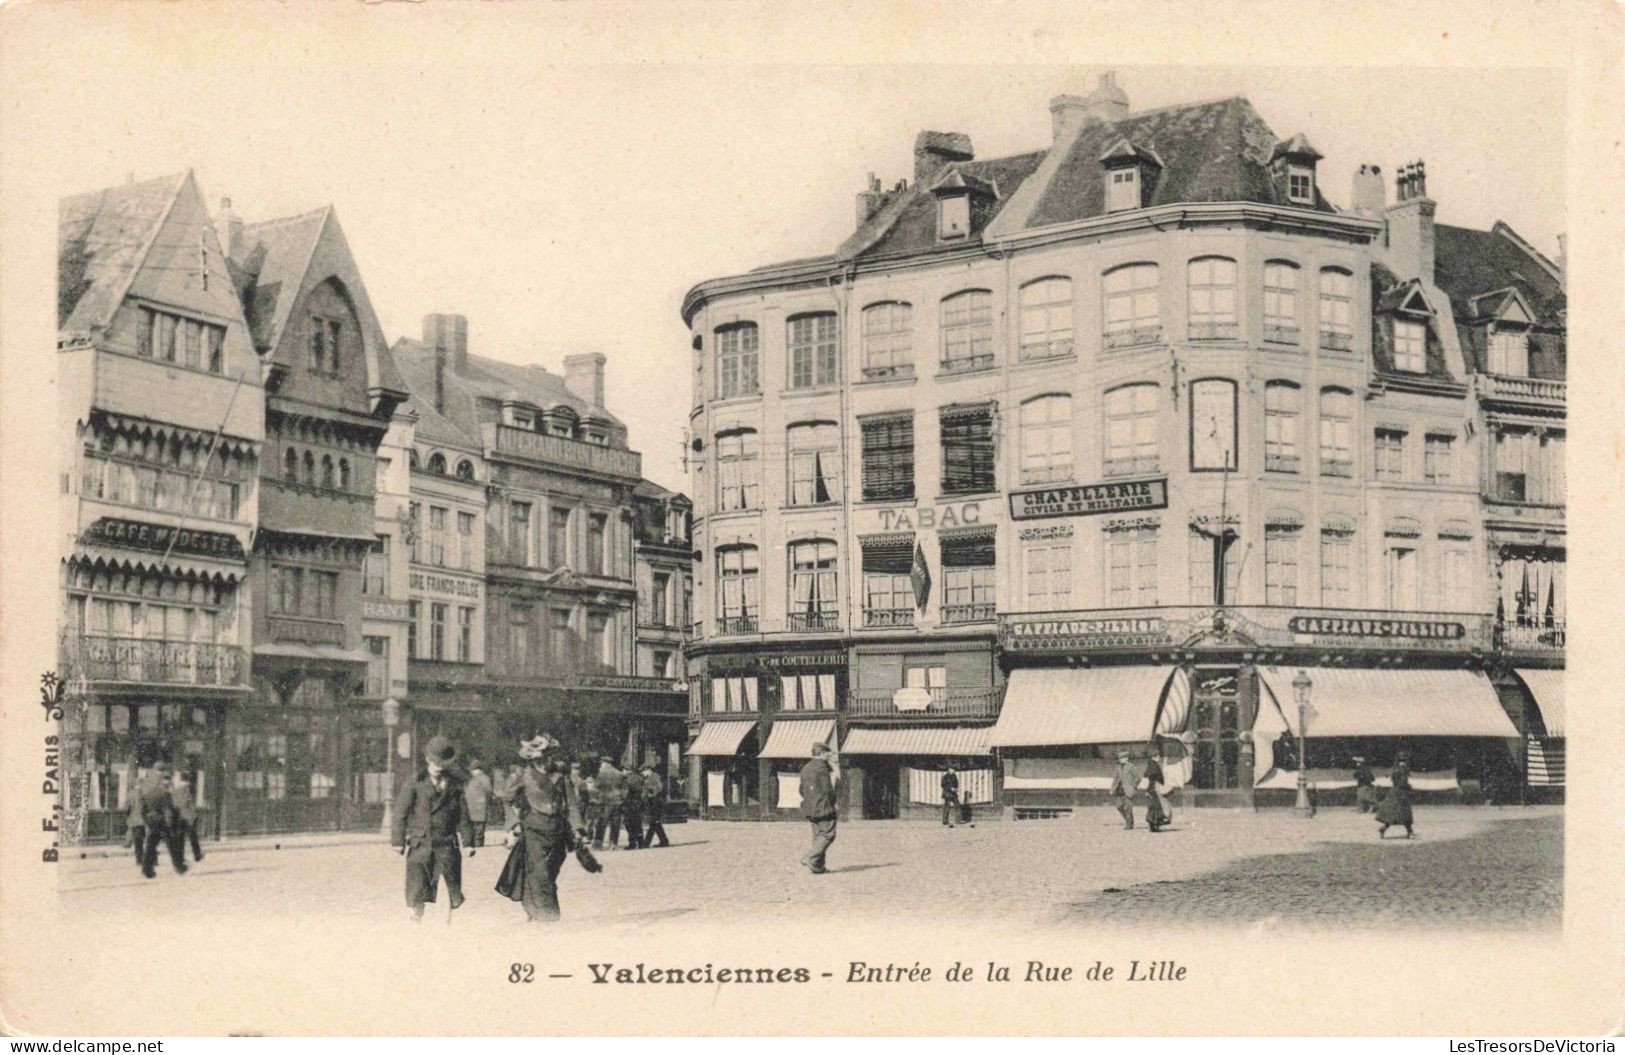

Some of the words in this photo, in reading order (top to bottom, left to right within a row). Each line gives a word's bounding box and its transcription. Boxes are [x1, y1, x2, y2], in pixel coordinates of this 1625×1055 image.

[1023, 483, 1151, 505] CHAPELLERIE
[1023, 503, 1063, 515] CIVILE
[1068, 501, 1083, 511] ET
[1088, 496, 1153, 510] MILITAIRE
[879, 503, 980, 530] TABAC
[781, 655, 848, 666] COUTELLERIE
